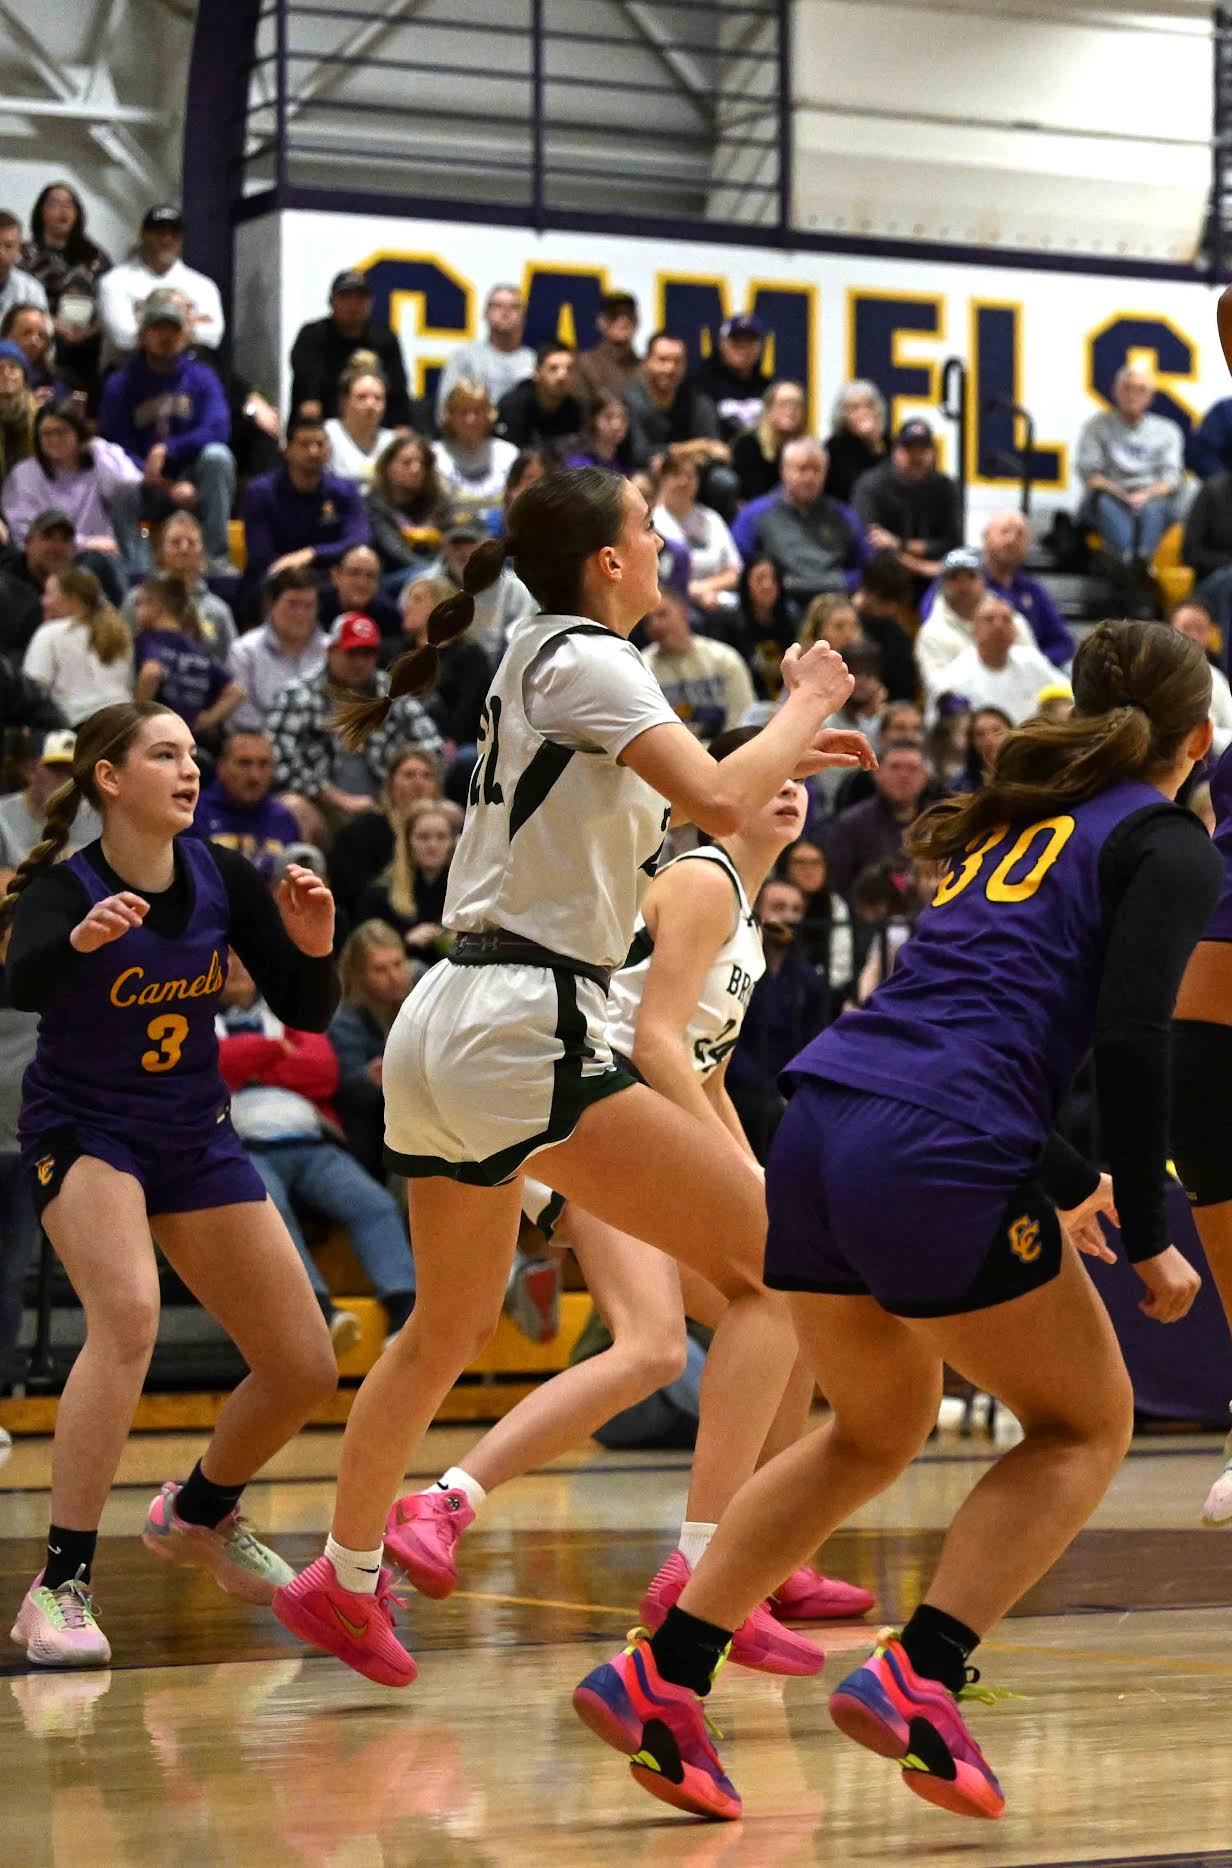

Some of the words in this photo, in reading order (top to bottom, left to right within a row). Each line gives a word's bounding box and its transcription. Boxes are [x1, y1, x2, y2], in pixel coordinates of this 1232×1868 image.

[359, 250, 1202, 488] CAMELS
[931, 814, 1076, 908] 30
[109, 949, 224, 1008] Camels
[141, 1013, 190, 1074] 3
